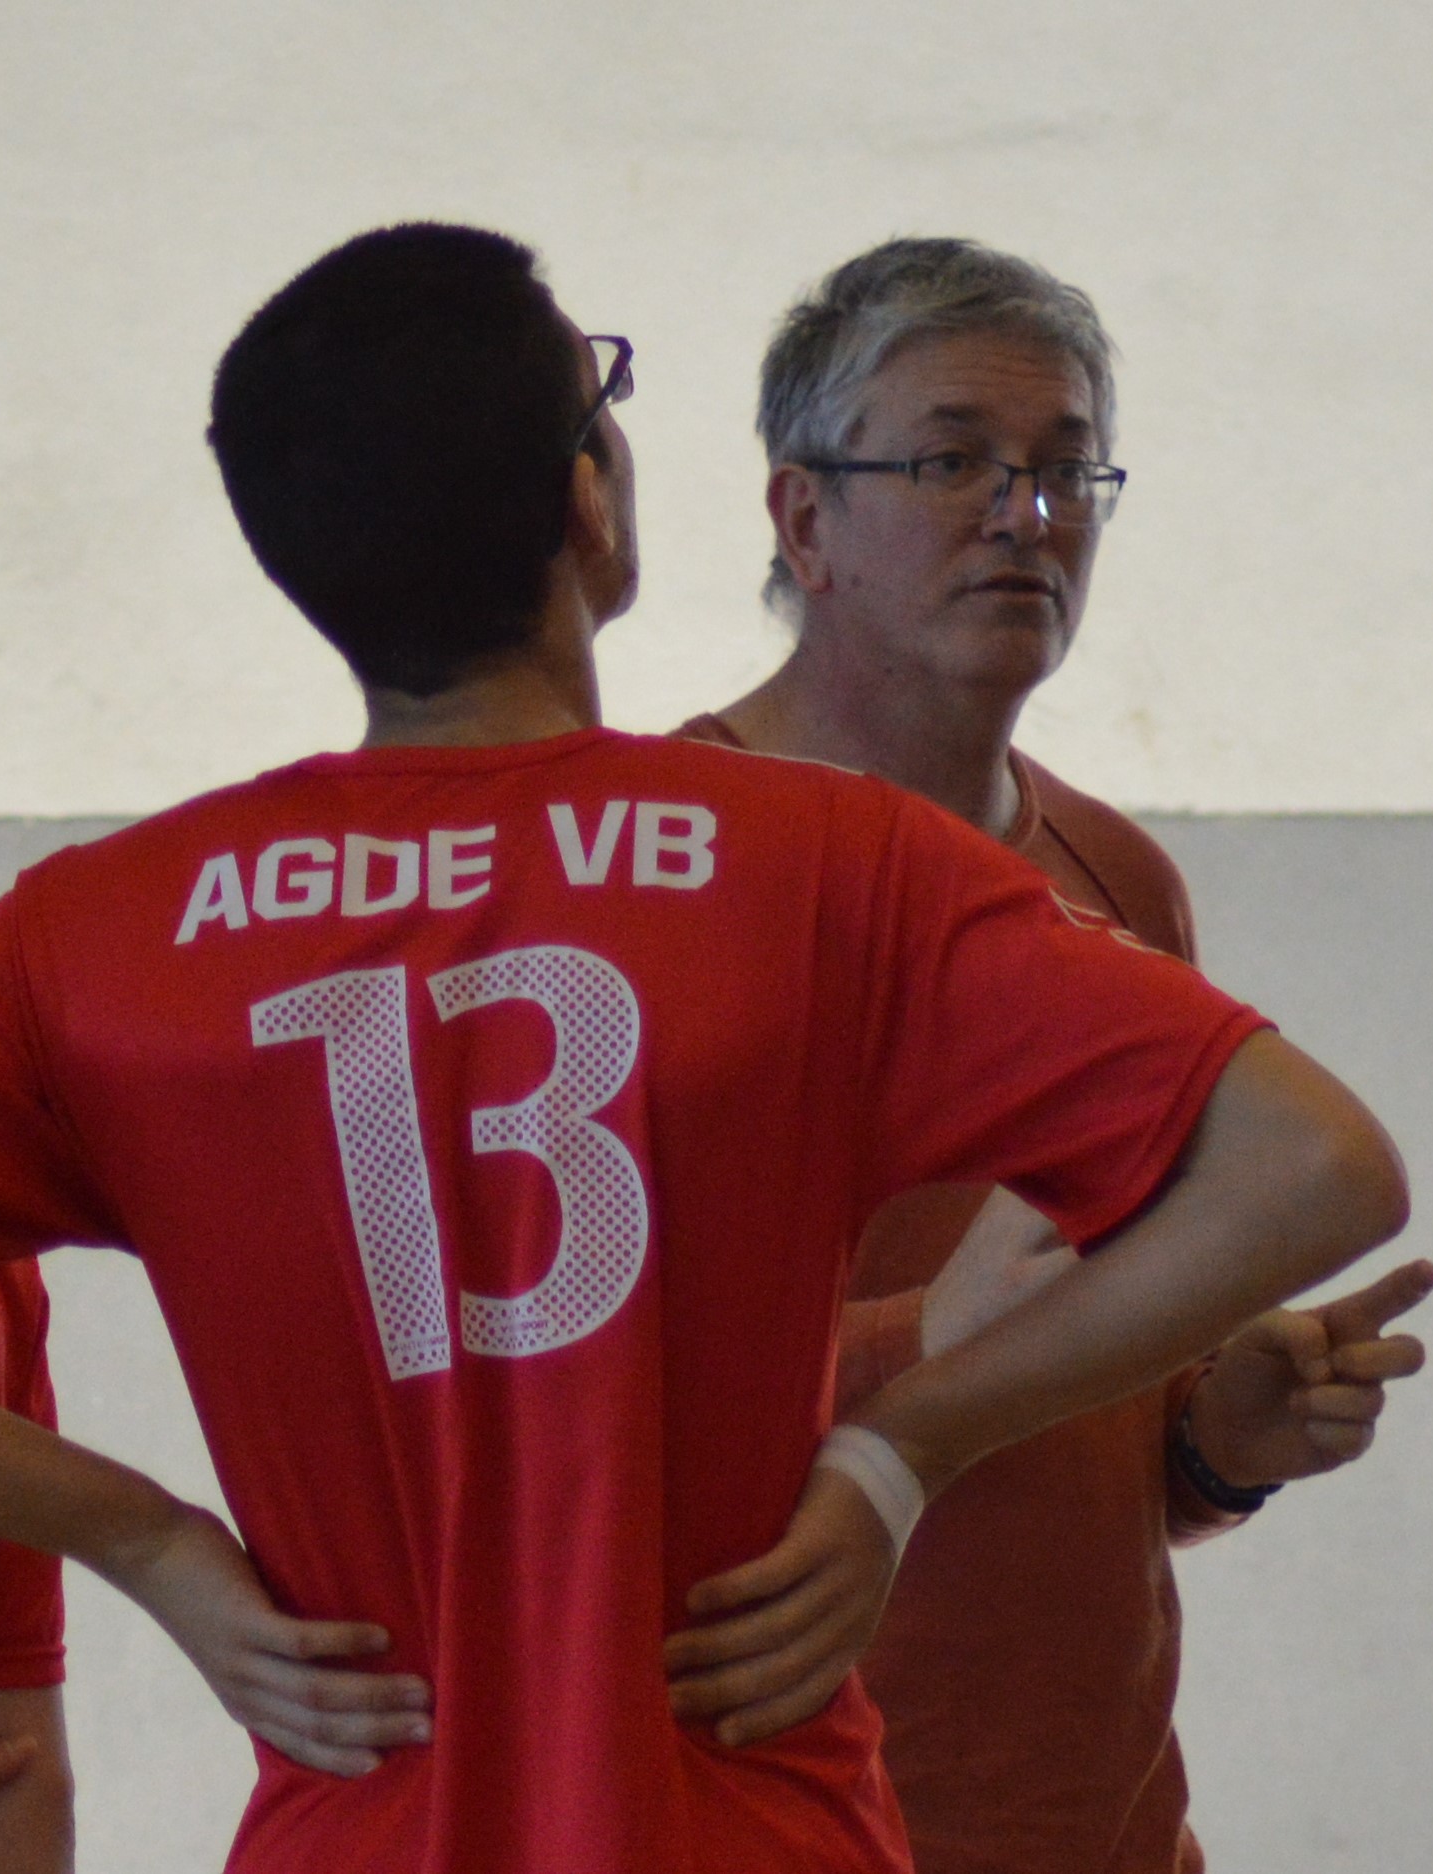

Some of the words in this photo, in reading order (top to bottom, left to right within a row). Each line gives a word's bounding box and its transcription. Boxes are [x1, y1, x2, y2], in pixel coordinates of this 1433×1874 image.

[174, 825, 496, 945] AGDE
[547, 800, 716, 890] VB
[249, 945, 648, 1381] 13
